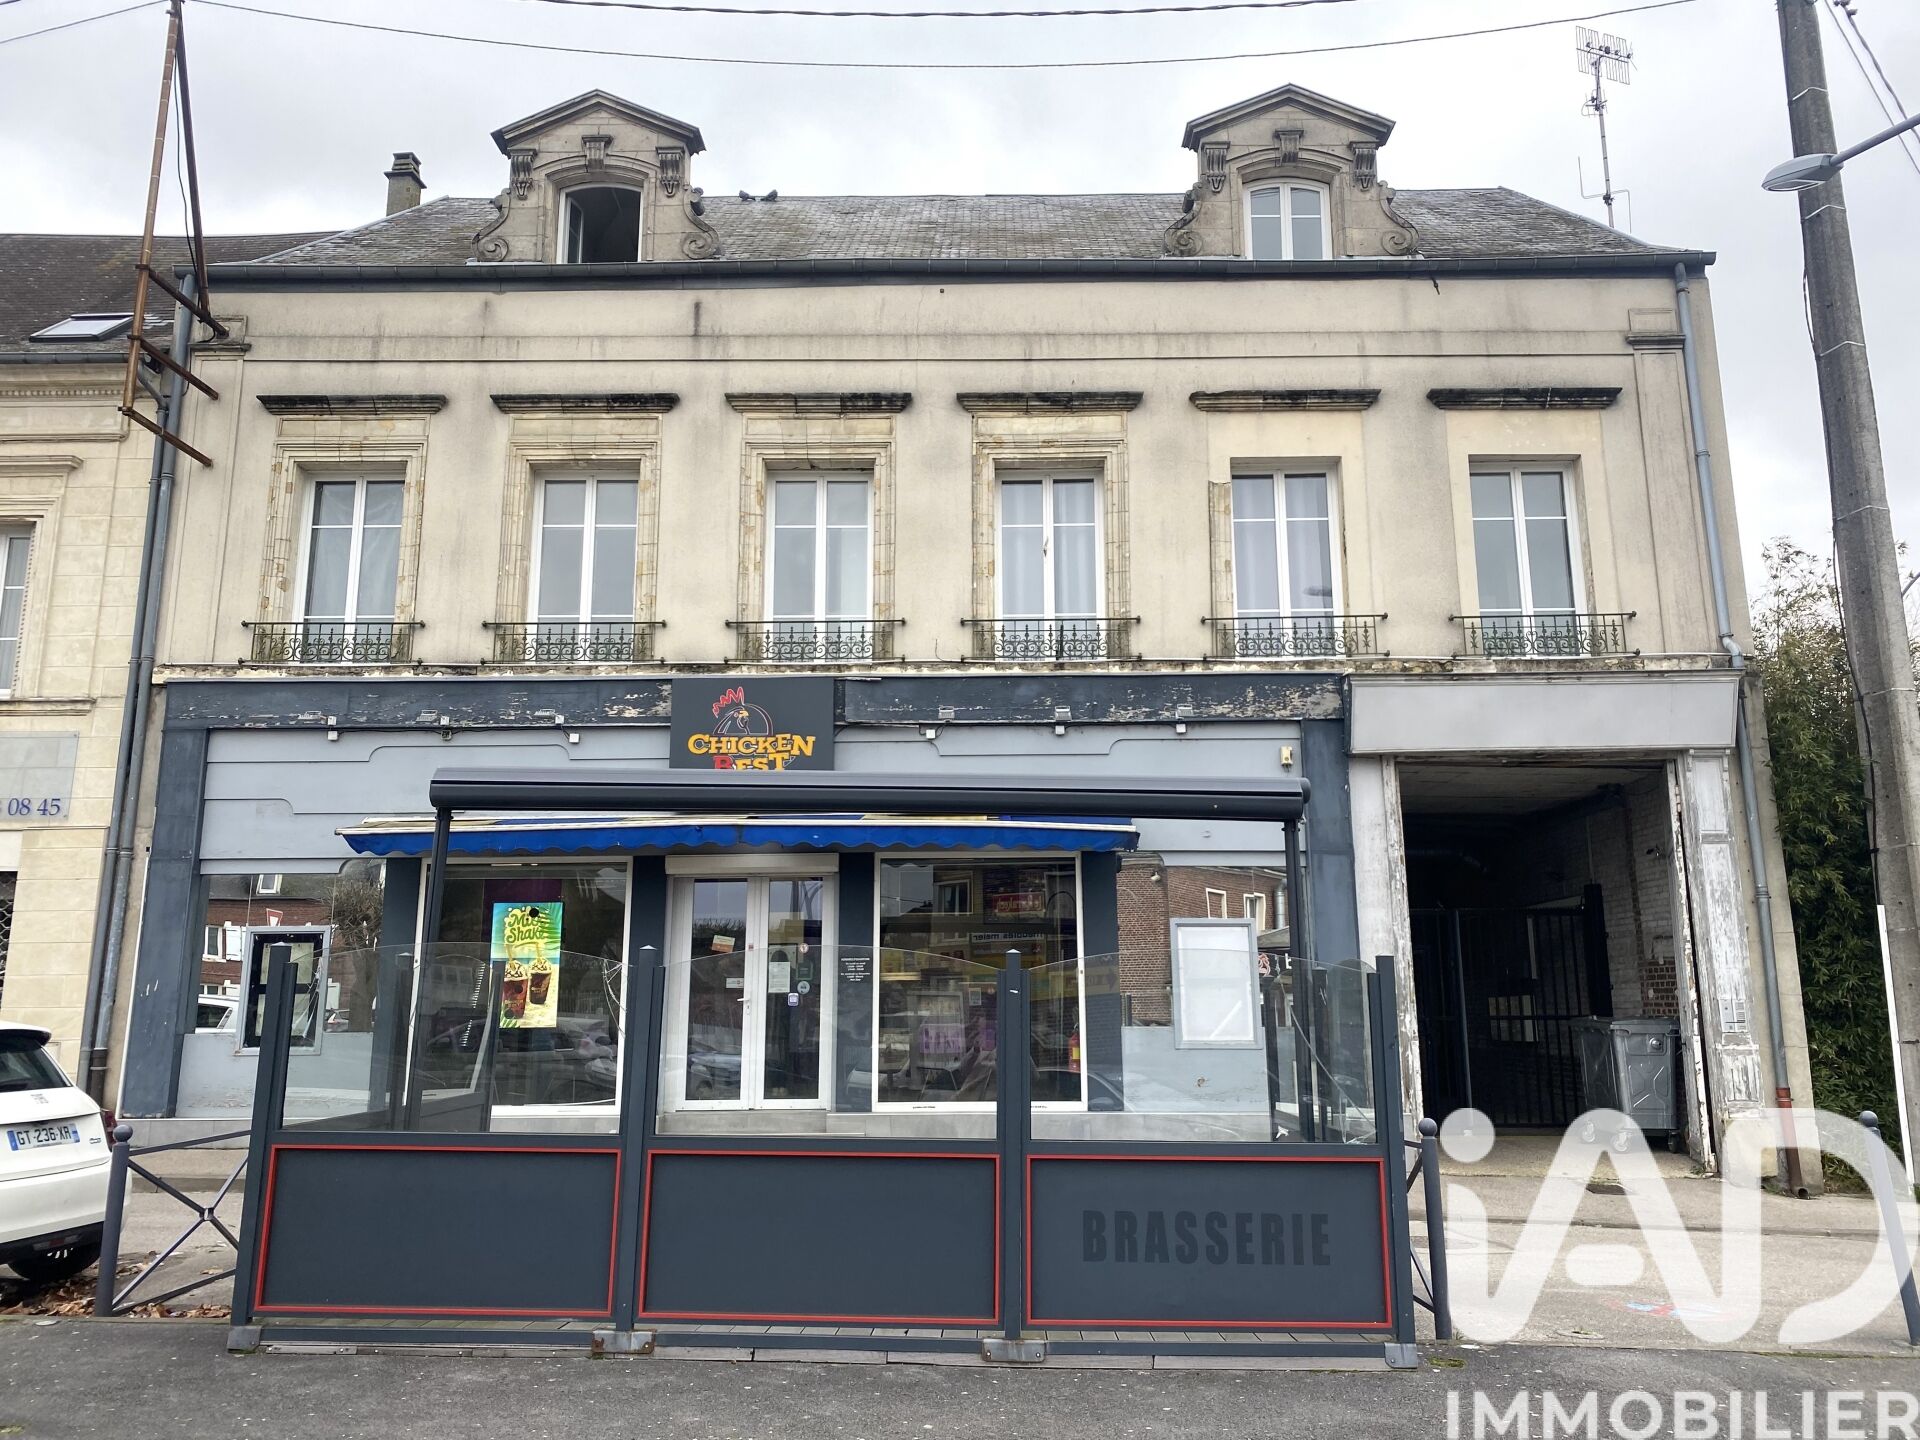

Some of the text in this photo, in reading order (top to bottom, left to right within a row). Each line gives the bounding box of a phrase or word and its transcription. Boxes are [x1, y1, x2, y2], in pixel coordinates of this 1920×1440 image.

[687, 733, 816, 756] CHICKEN
[8, 798, 61, 816] 08 45
[1082, 1210, 1331, 1266] BRASSERIE
